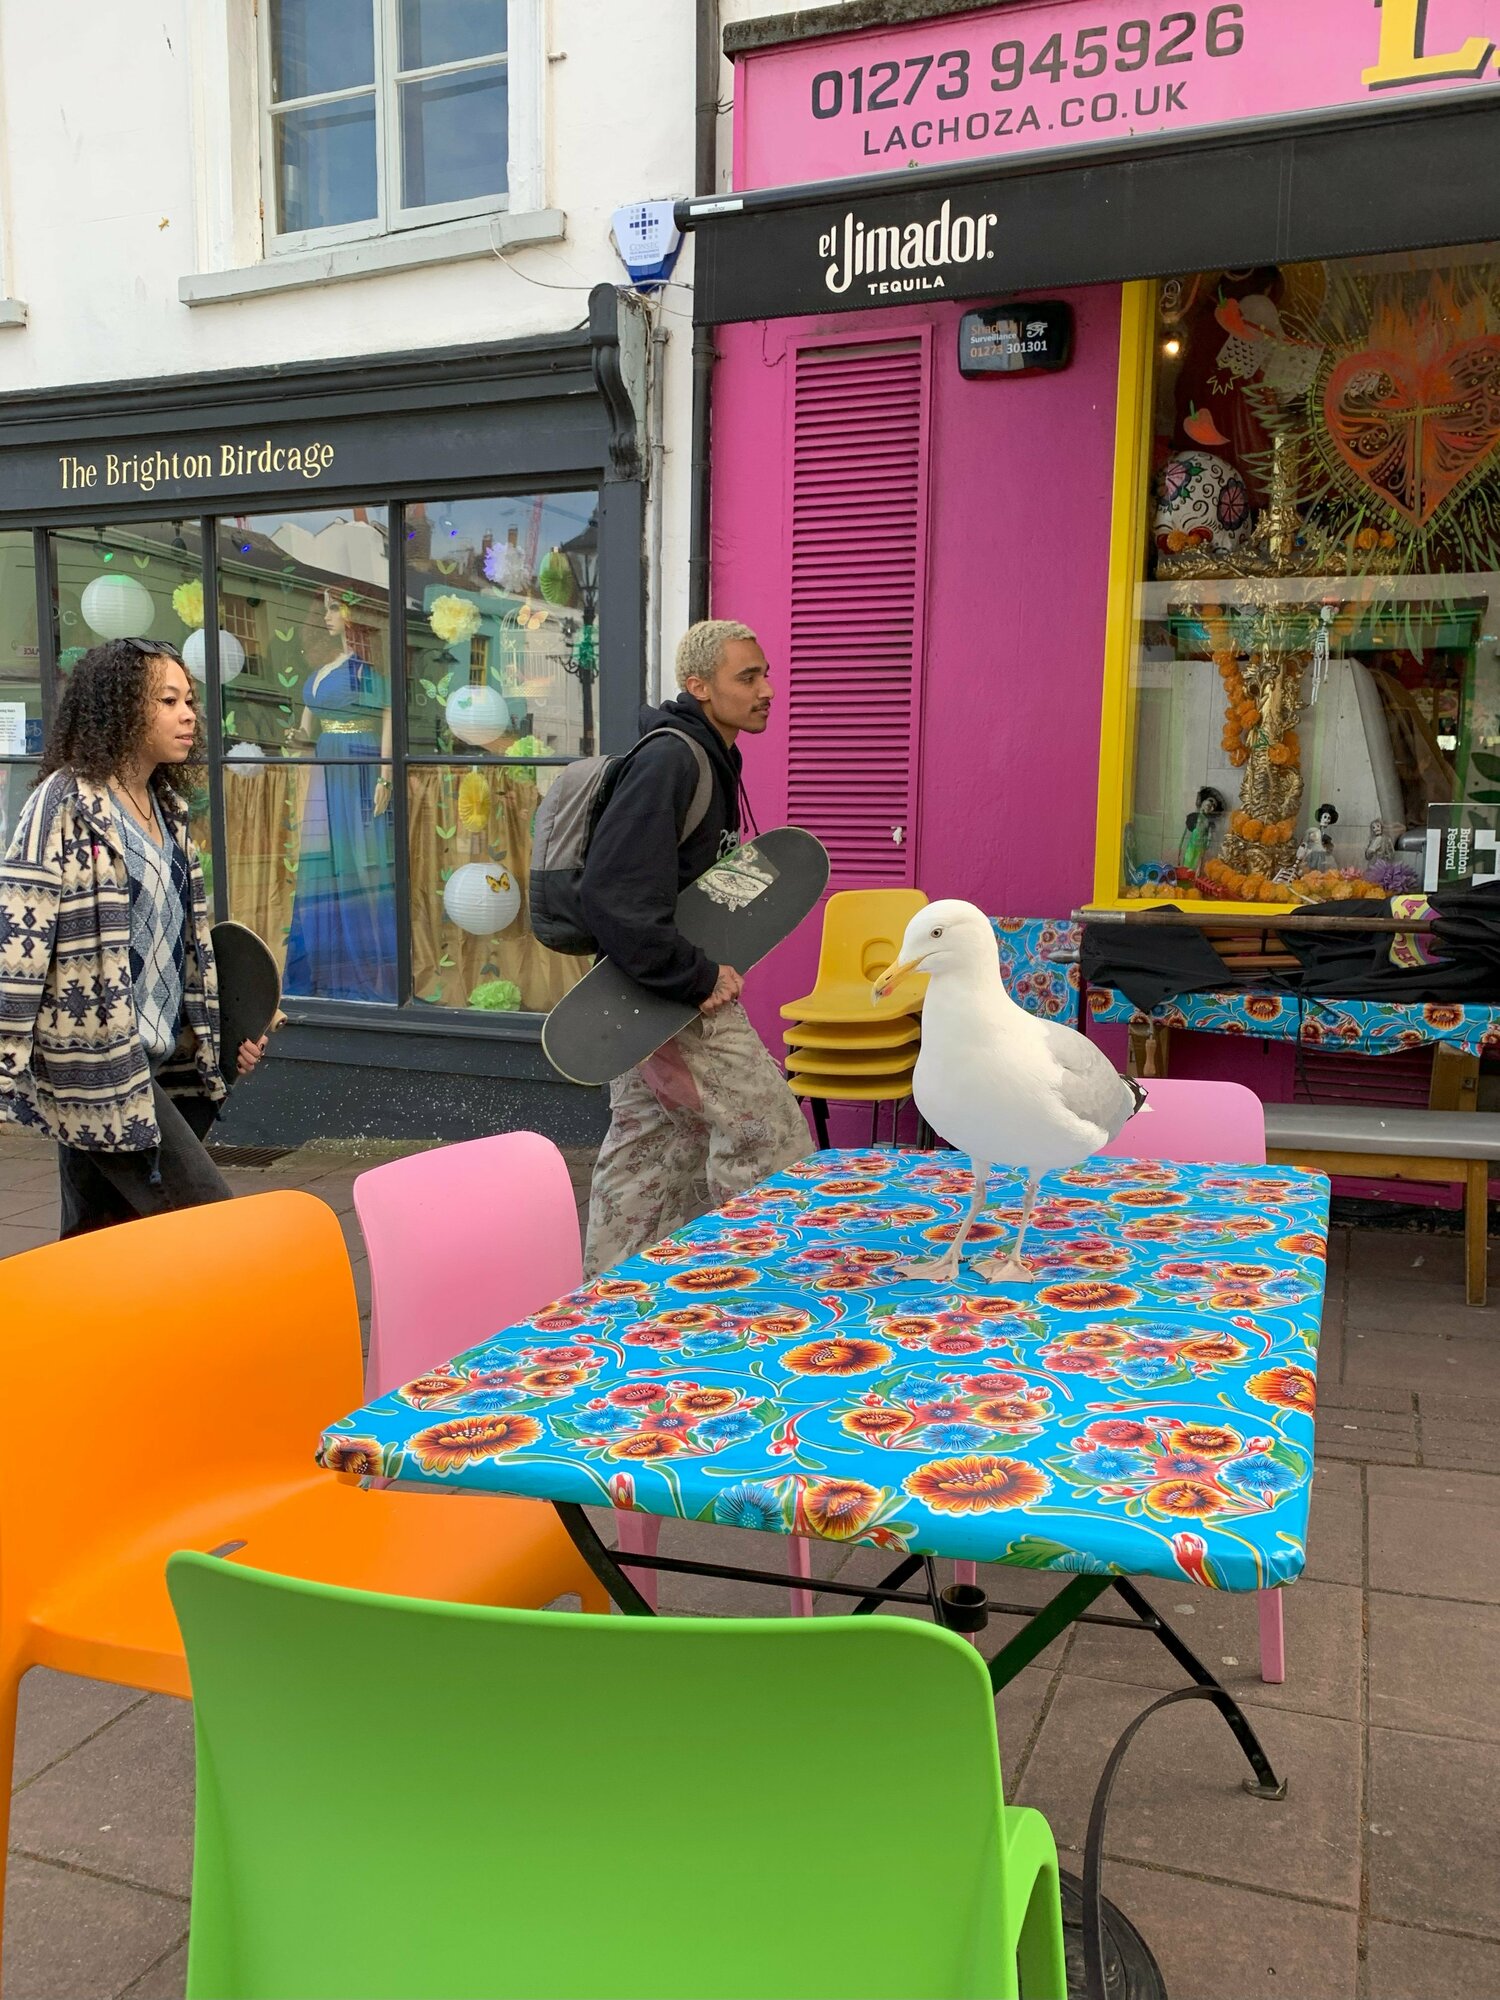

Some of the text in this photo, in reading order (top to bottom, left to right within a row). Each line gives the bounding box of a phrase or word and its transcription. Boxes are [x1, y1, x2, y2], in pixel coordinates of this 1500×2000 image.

[811, 4, 1245, 119] 01273 945926
[1361, 0, 1500, 91] L
[864, 81, 1188, 155] LACHOZA.CO.UK
[819, 226, 836, 258] el
[868, 275, 945, 295] TEQUILA
[970, 333, 1017, 344] Surveillance
[970, 340, 1047, 358] 01273 301301
[59, 441, 334, 491] The Brighton Birdcage
[1445, 828, 1458, 871] Festival
[1458, 828, 1471, 875] Brighton
